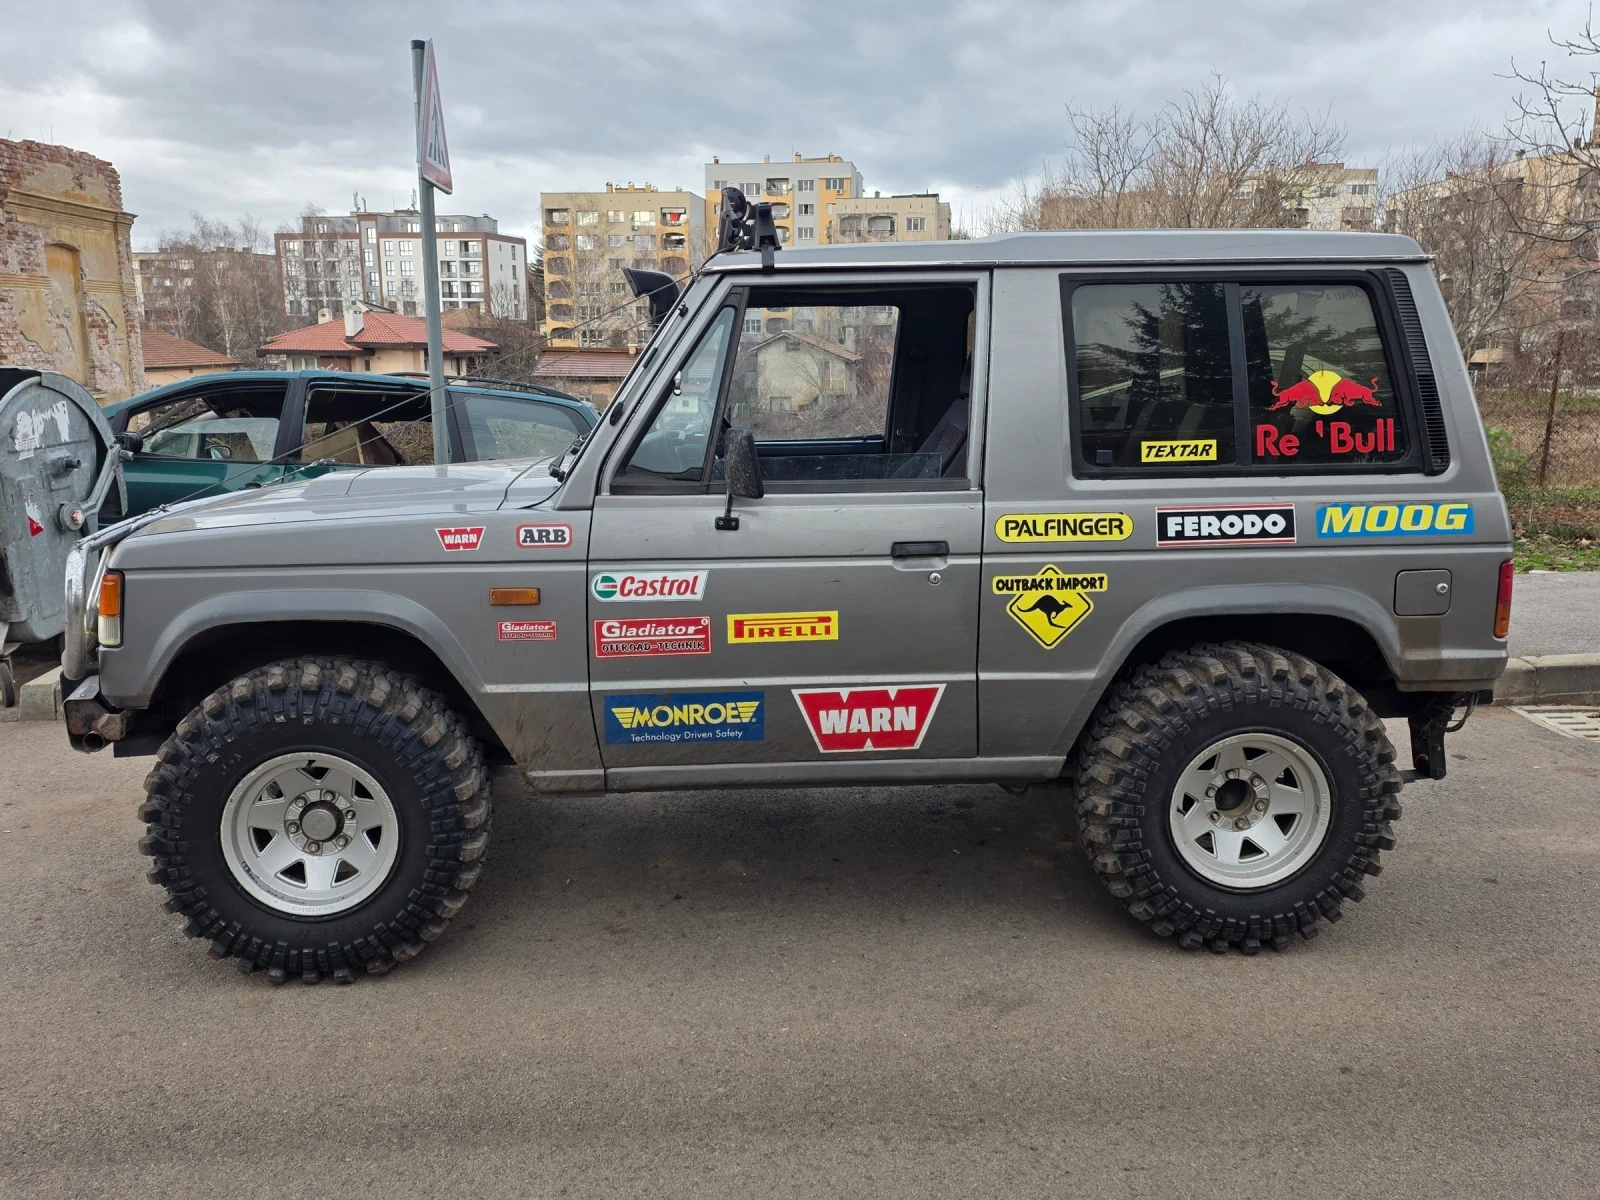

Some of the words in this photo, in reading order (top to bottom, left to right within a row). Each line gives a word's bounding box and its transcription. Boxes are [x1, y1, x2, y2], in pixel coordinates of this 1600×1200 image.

[1256, 421, 1323, 456] Re
[1145, 443, 1213, 459] TEXTAR
[1004, 517, 1124, 538] PALFINGER
[1167, 513, 1286, 537] FERODO
[1321, 503, 1469, 533] MOOG
[443, 533, 478, 545] WARN
[521, 528, 567, 544] ARB
[619, 575, 699, 597] Castrol
[995, 578, 1053, 592] OUTBACK
[1056, 576, 1105, 591] IMPORT
[501, 622, 553, 631] Gladiator
[601, 621, 703, 638] Gladiator
[733, 615, 832, 639] PIRELLI
[602, 641, 705, 653] OFFROAD-TECHNIK
[631, 702, 742, 729] MONROE
[818, 706, 917, 735] WARN
[630, 732, 681, 742] Technology
[684, 730, 713, 740] Driven
[715, 729, 743, 739] Safety
